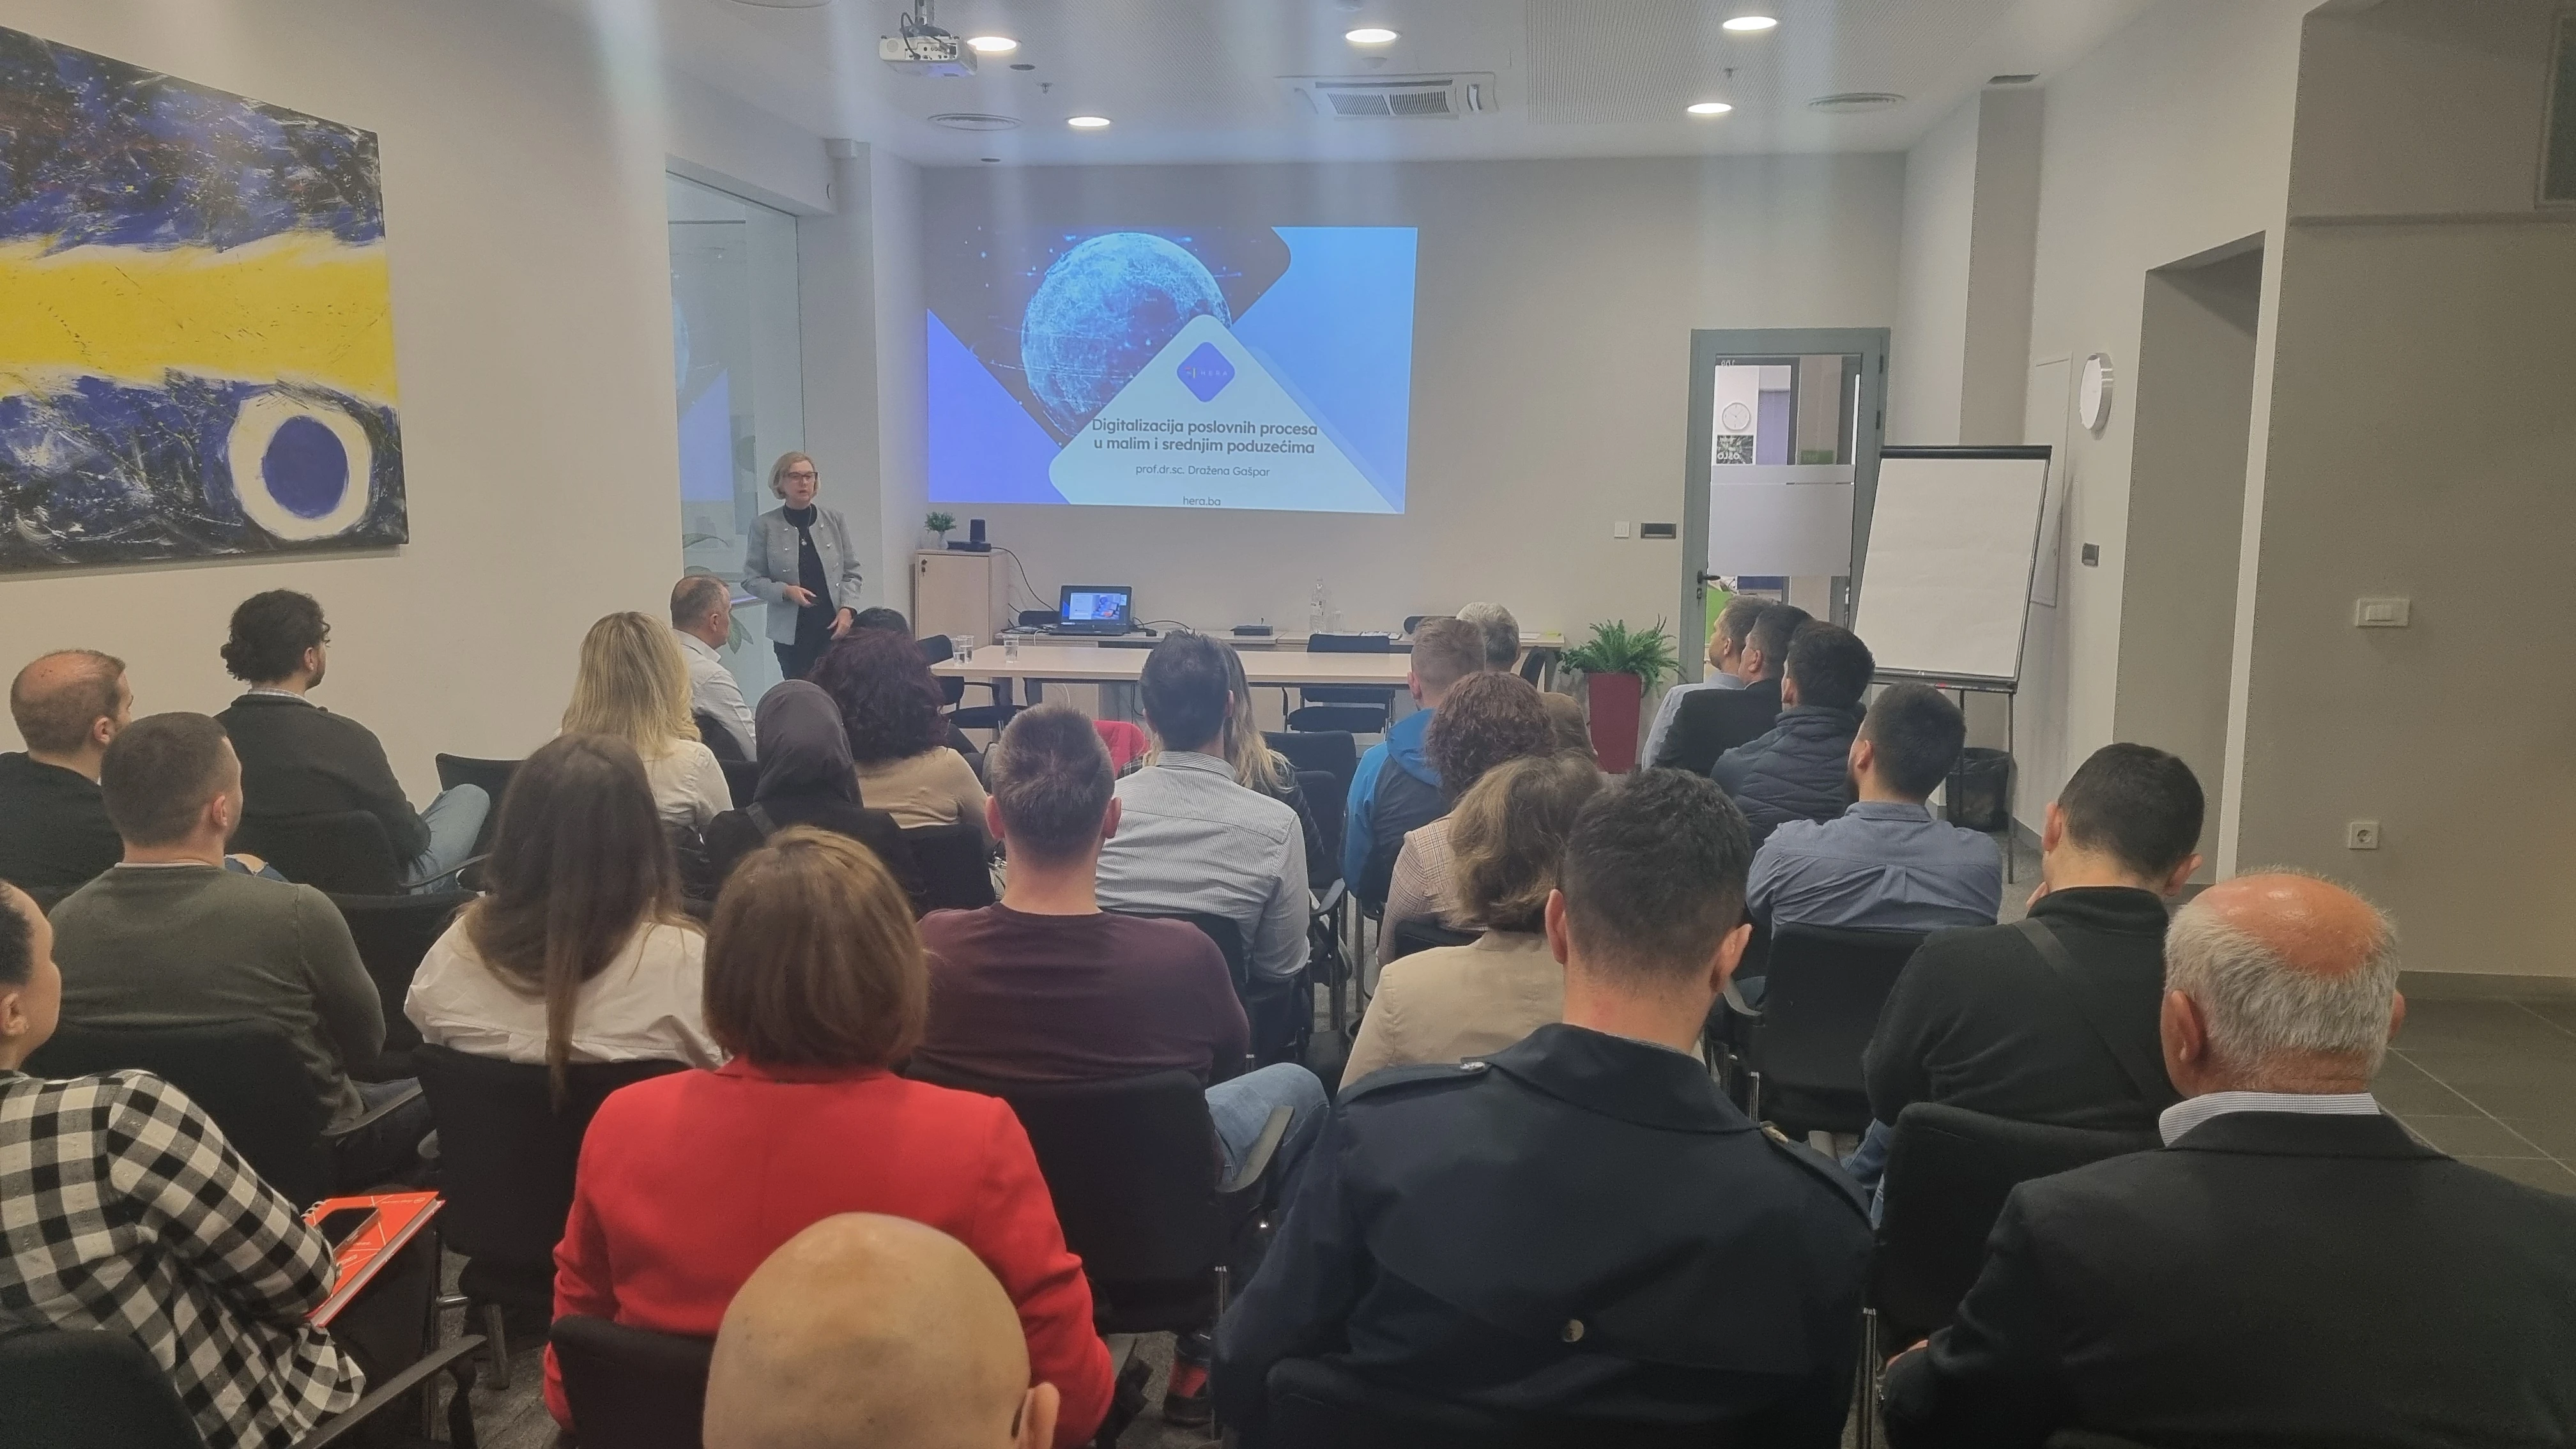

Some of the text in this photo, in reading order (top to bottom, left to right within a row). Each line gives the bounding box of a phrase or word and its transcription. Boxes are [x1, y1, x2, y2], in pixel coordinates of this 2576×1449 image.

[1092, 418, 1317, 438] Digitalizacija poslovnih procesa
[1094, 436, 1315, 455] u malim i srednjim poduzećima
[1135, 464, 1271, 478] prof.dr.sc. Dražena Gašpar
[1183, 496, 1221, 506] hera.ba
